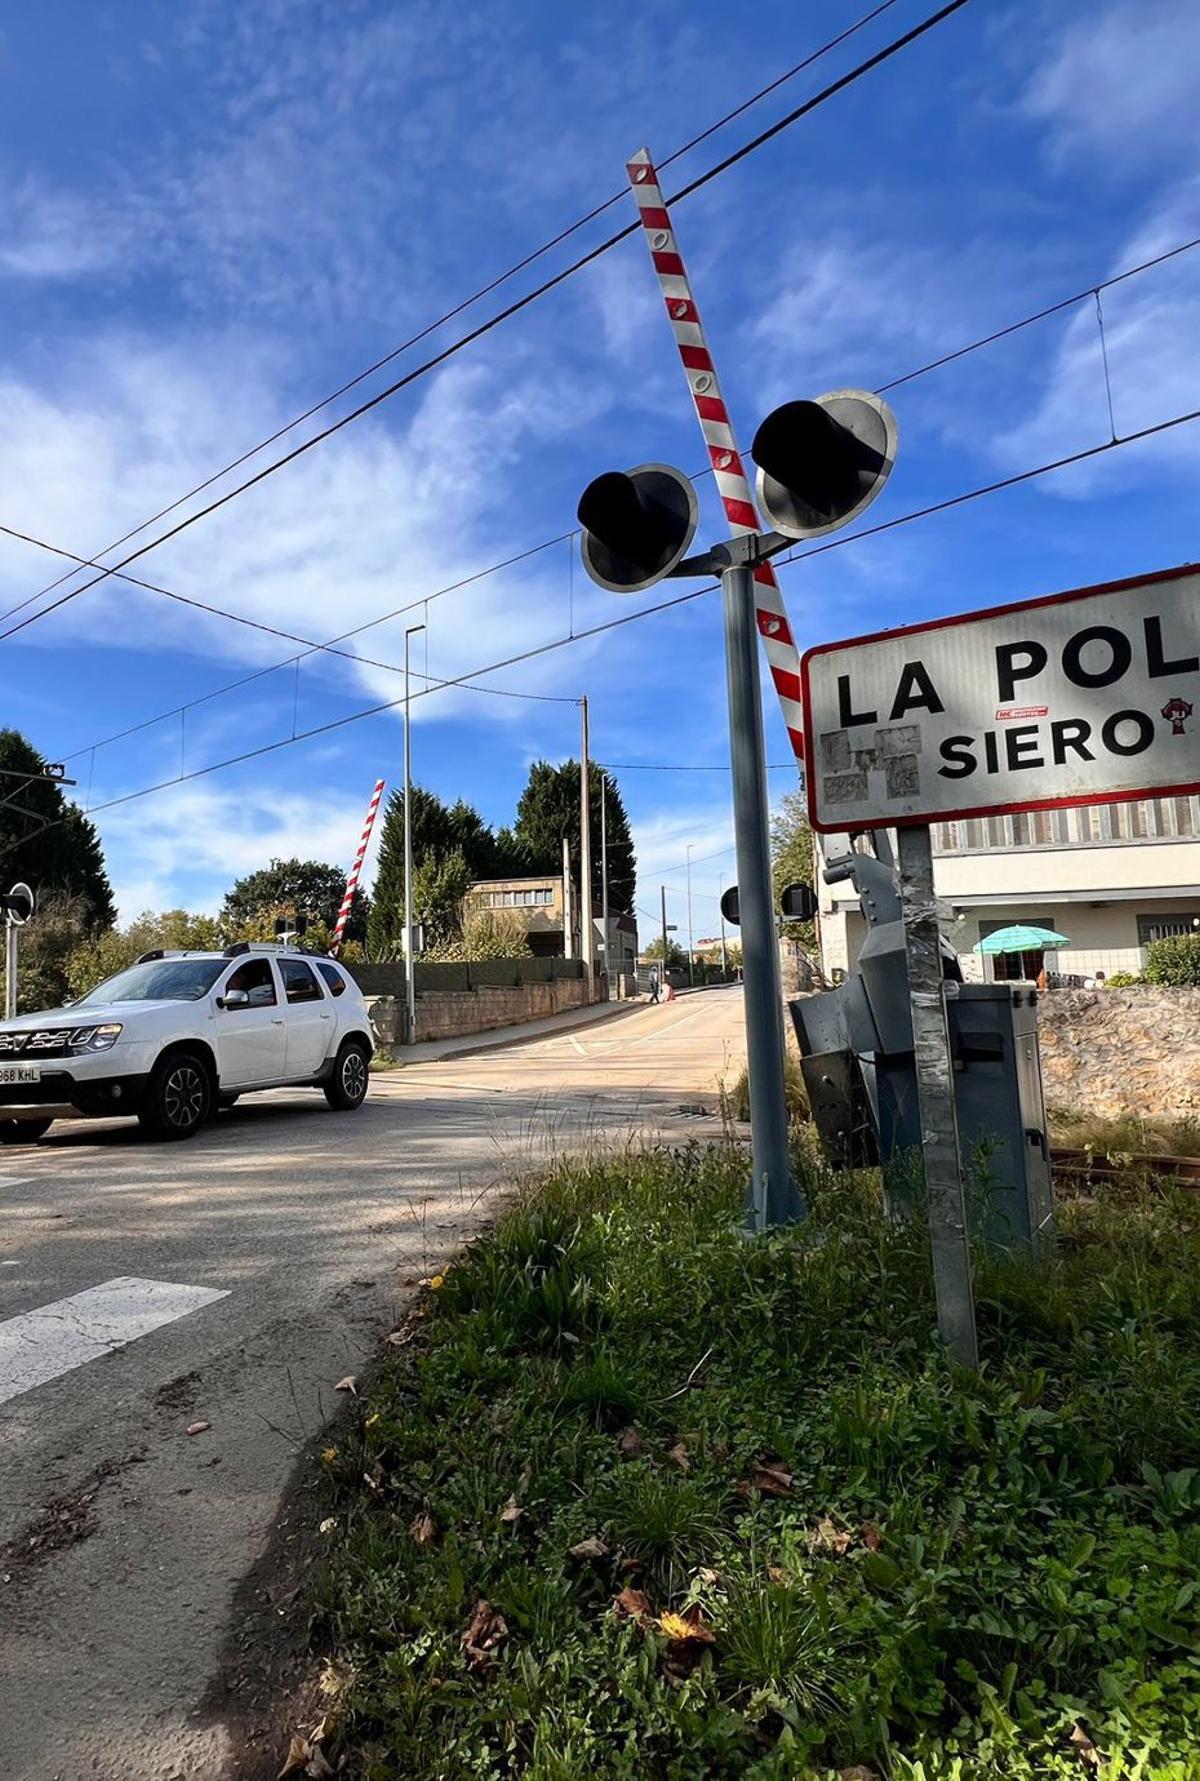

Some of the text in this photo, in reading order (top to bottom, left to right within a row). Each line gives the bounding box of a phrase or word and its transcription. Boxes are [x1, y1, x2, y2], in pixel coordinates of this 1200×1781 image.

[838, 661, 945, 728] LA
[937, 710, 1155, 779] SIERO
[18, 1069, 38, 1081] KHL
